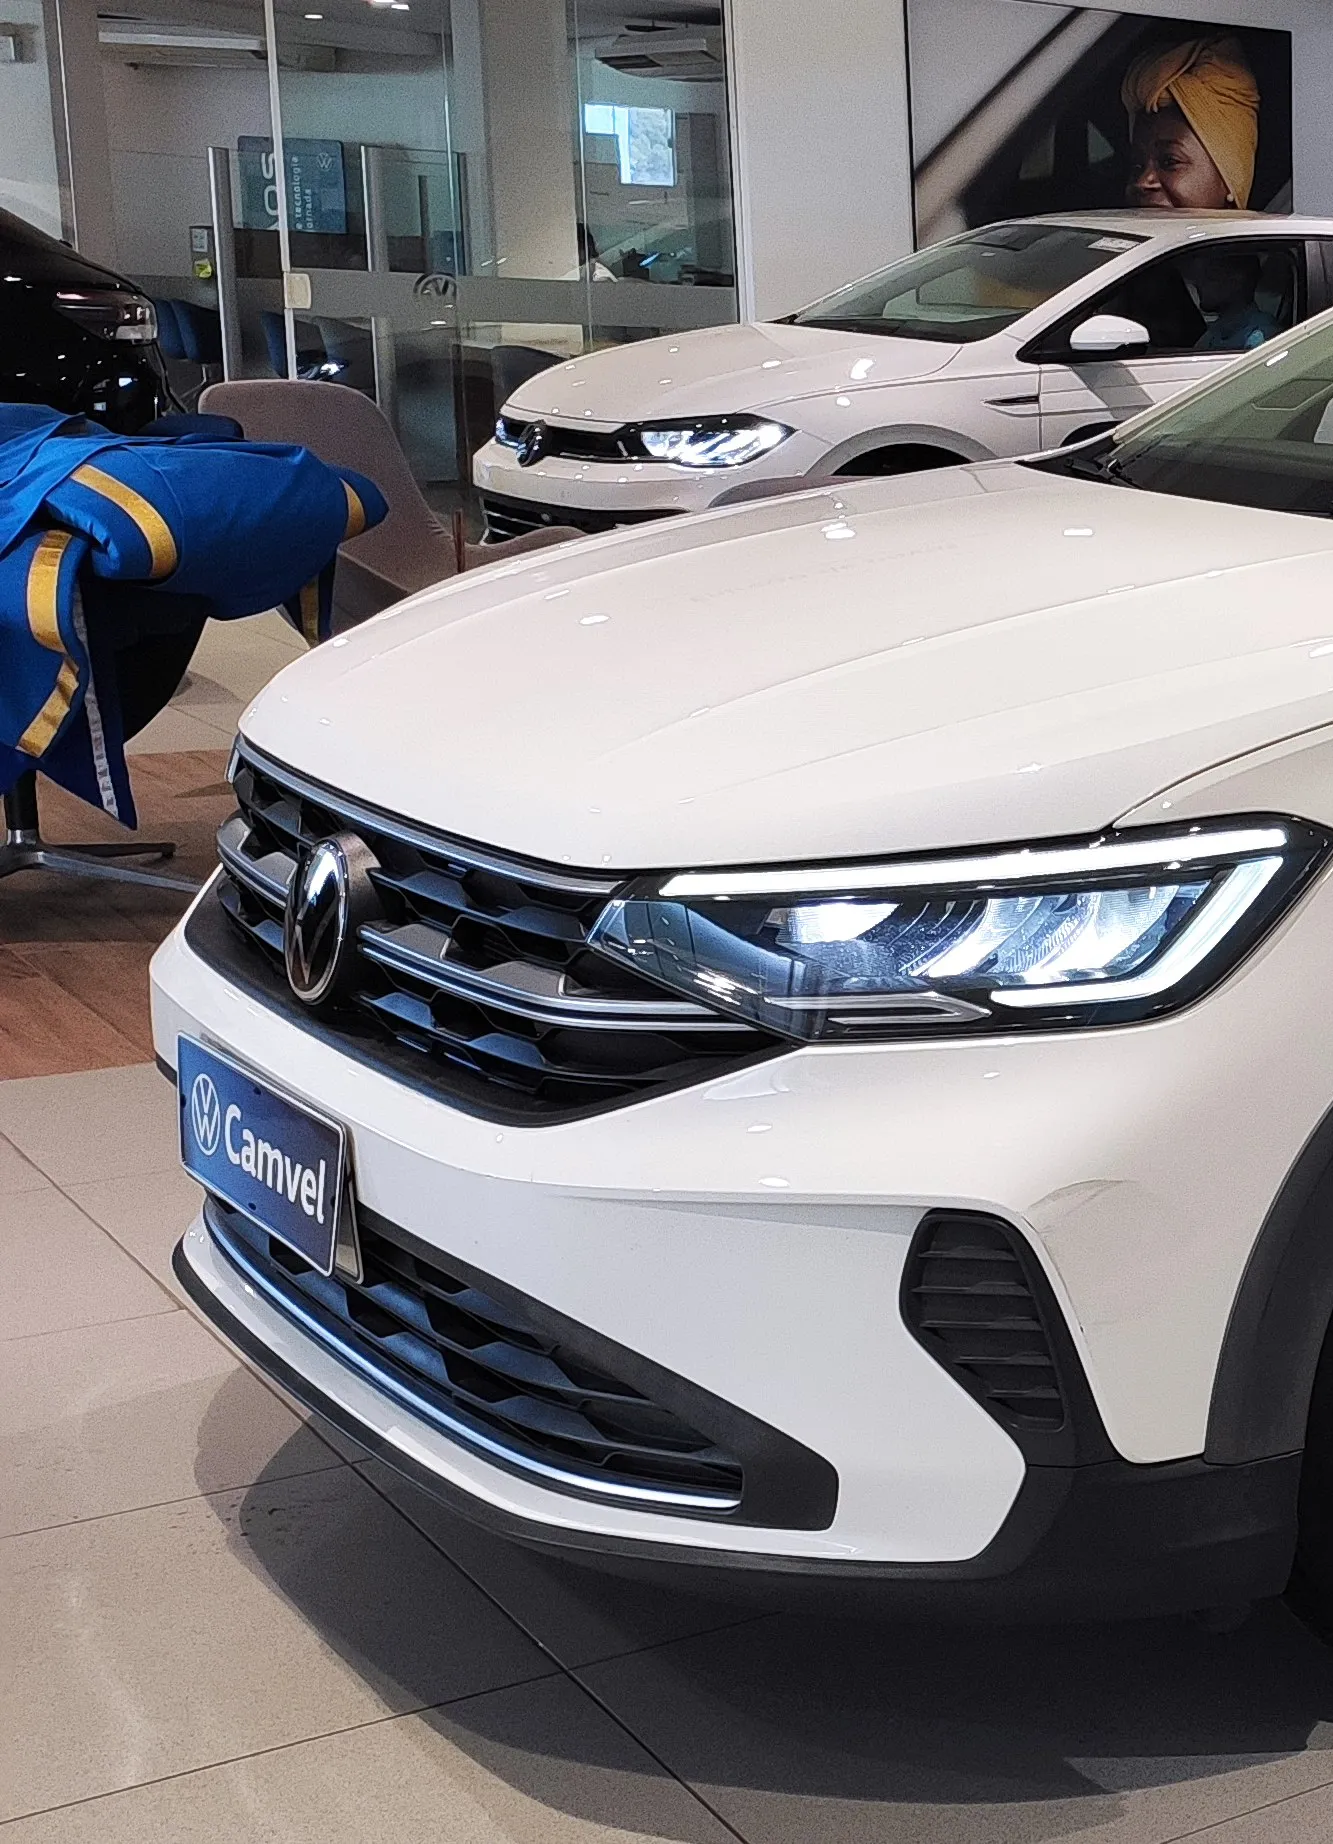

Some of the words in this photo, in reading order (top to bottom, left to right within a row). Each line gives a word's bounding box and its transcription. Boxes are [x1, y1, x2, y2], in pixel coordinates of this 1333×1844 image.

[261, 152, 280, 230] OS
[303, 188, 314, 230] ornada
[191, 1073, 221, 1156] VW
[224, 1104, 326, 1225] Camvel
